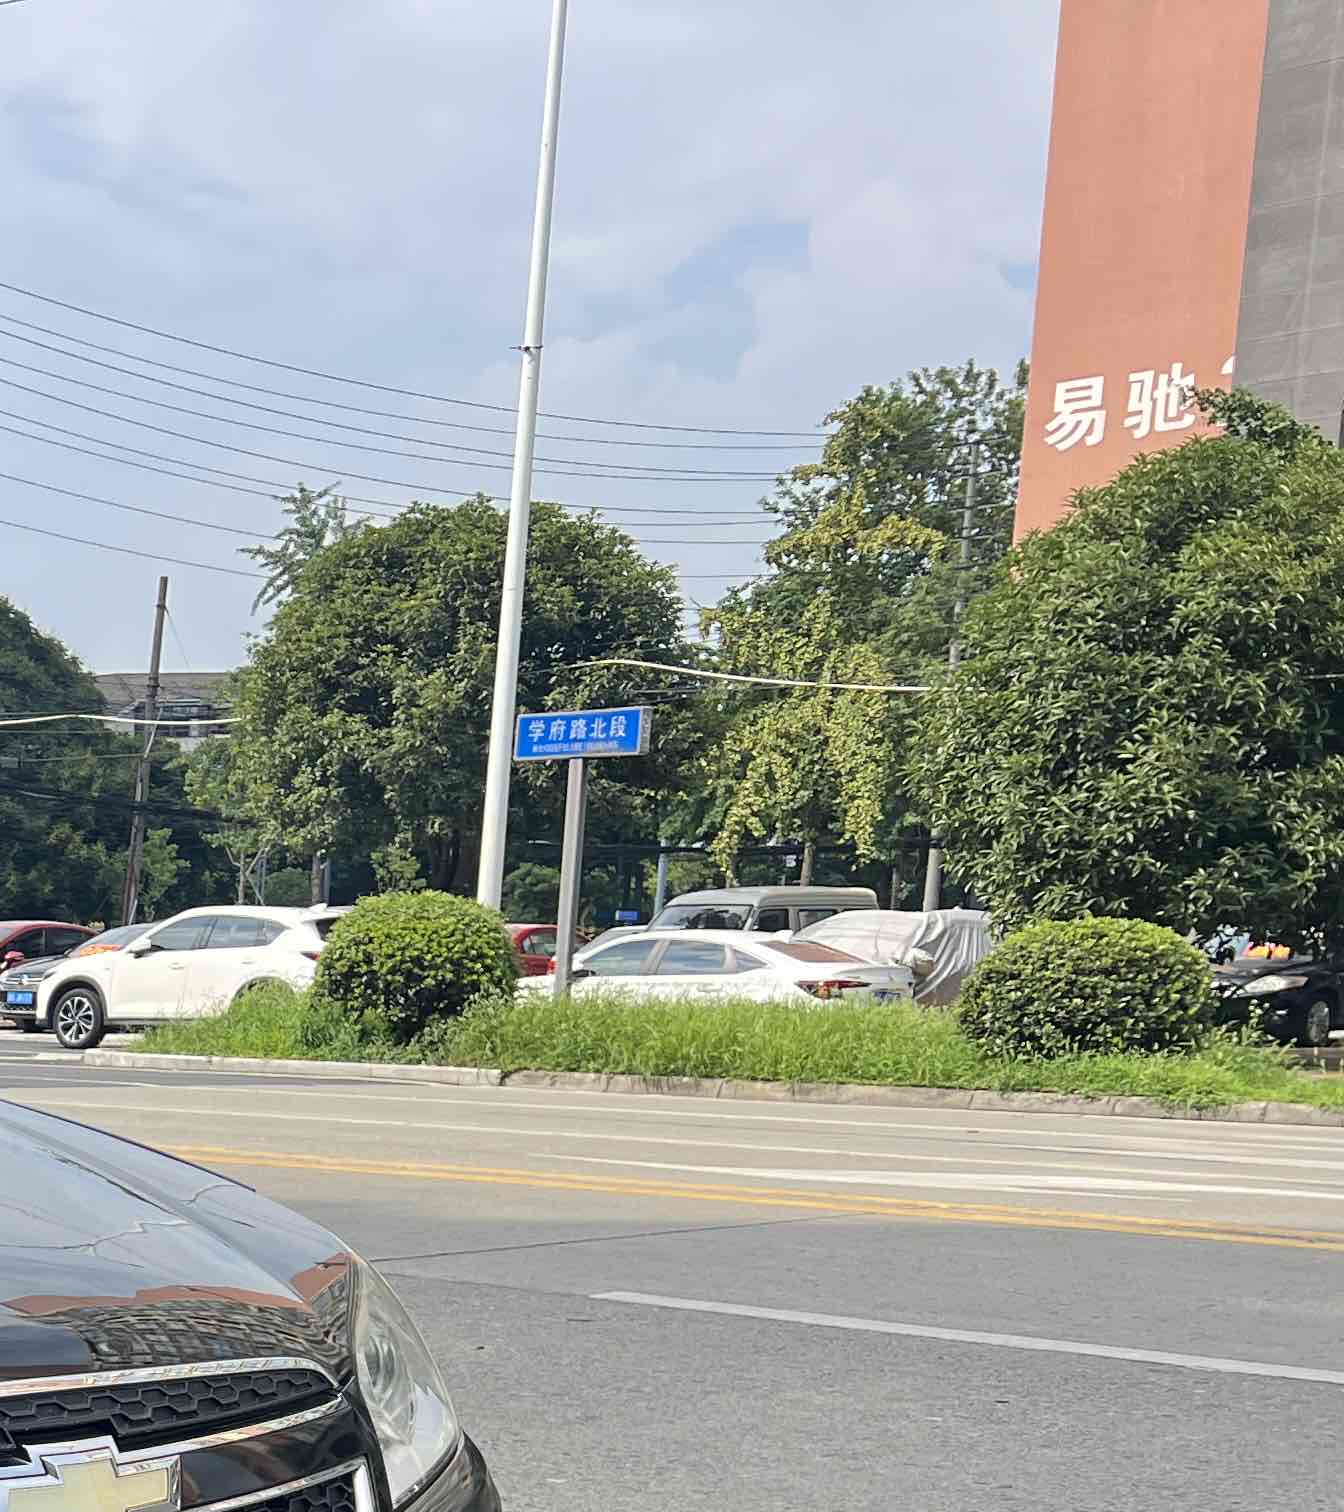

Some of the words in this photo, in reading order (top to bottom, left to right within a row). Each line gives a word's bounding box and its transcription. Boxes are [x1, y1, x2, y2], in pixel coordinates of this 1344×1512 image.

[1044, 357, 1235, 450] 易驰
[528, 715, 627, 742] 学府路北段
